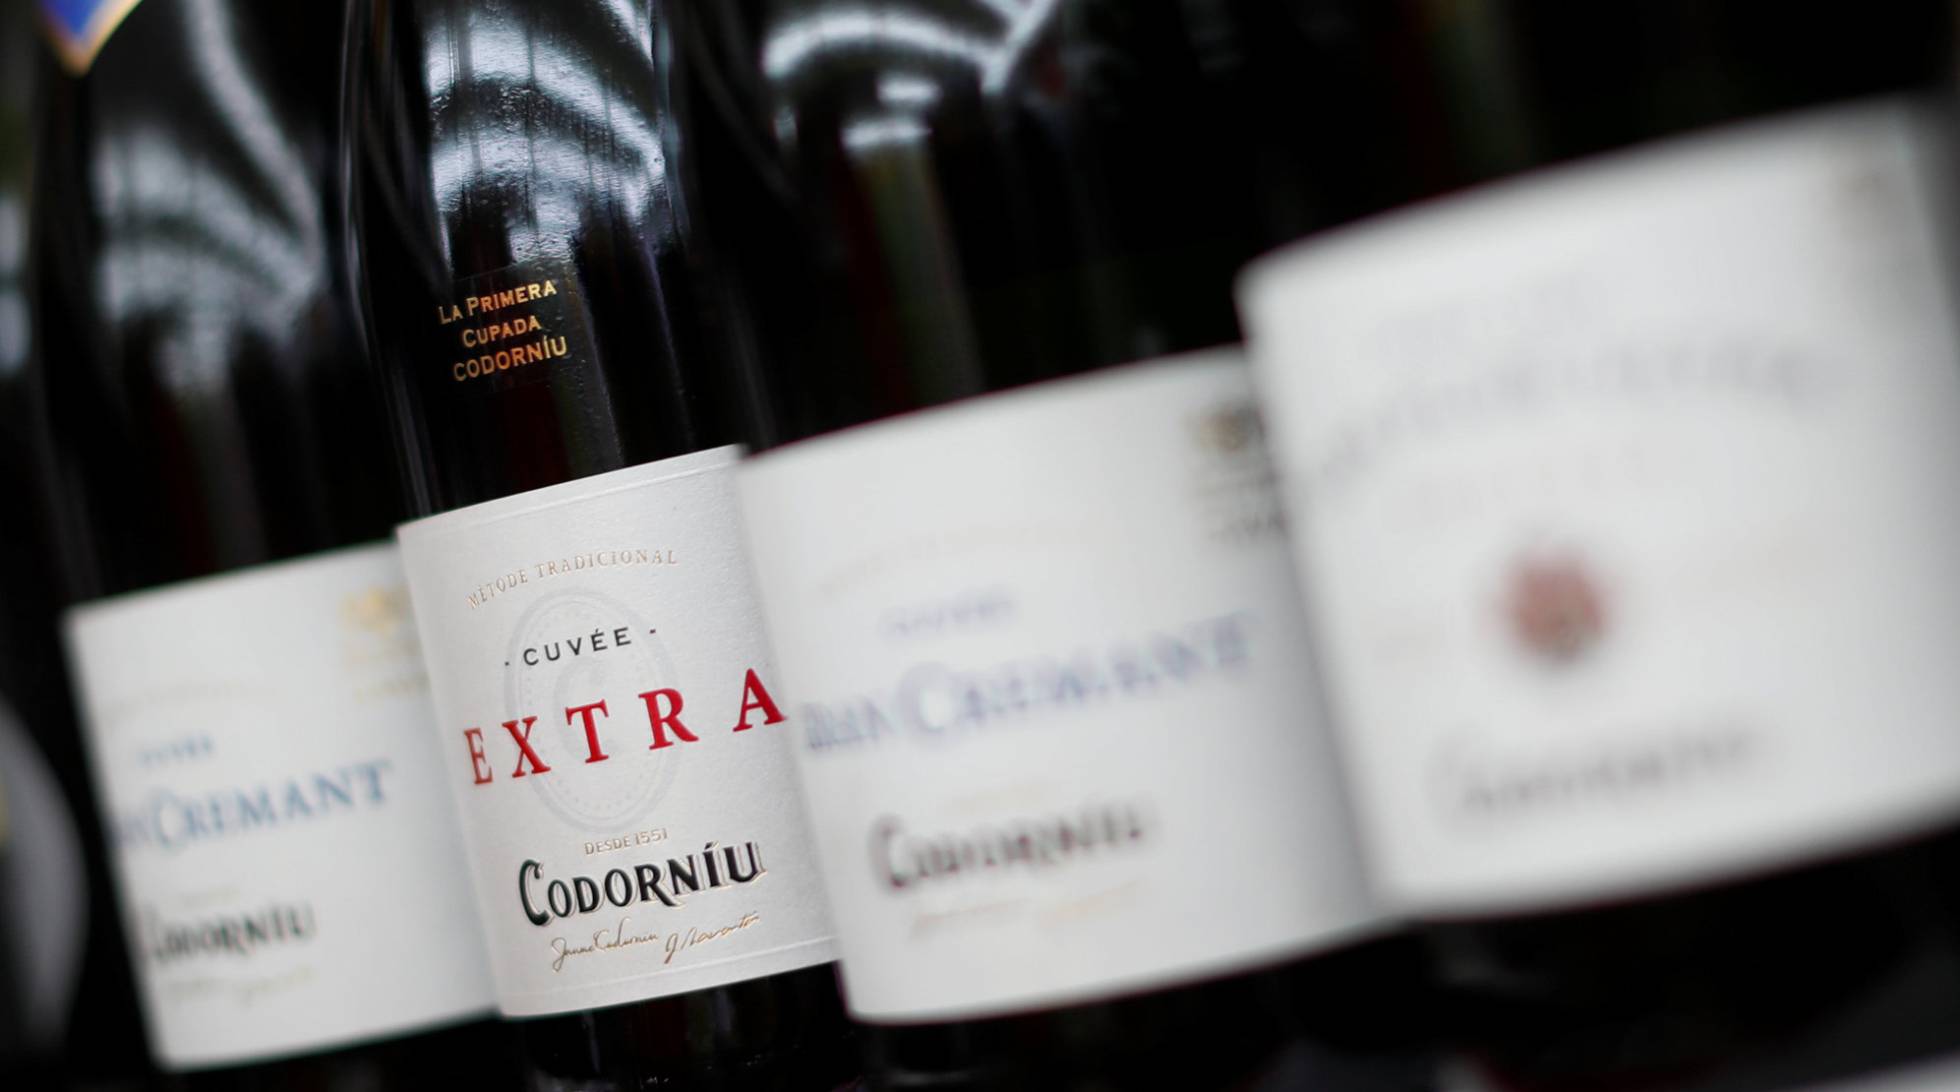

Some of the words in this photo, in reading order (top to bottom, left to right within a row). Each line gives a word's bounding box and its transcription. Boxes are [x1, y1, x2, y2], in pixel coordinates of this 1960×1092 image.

[453, 334, 567, 382] CODORNÍU
[534, 549, 679, 579] TRADICIONAL
[522, 627, 632, 667] CUVÉE
[464, 667, 788, 786] EXTRA
[583, 835, 632, 856] DESDE
[633, 827, 669, 846] 1551
